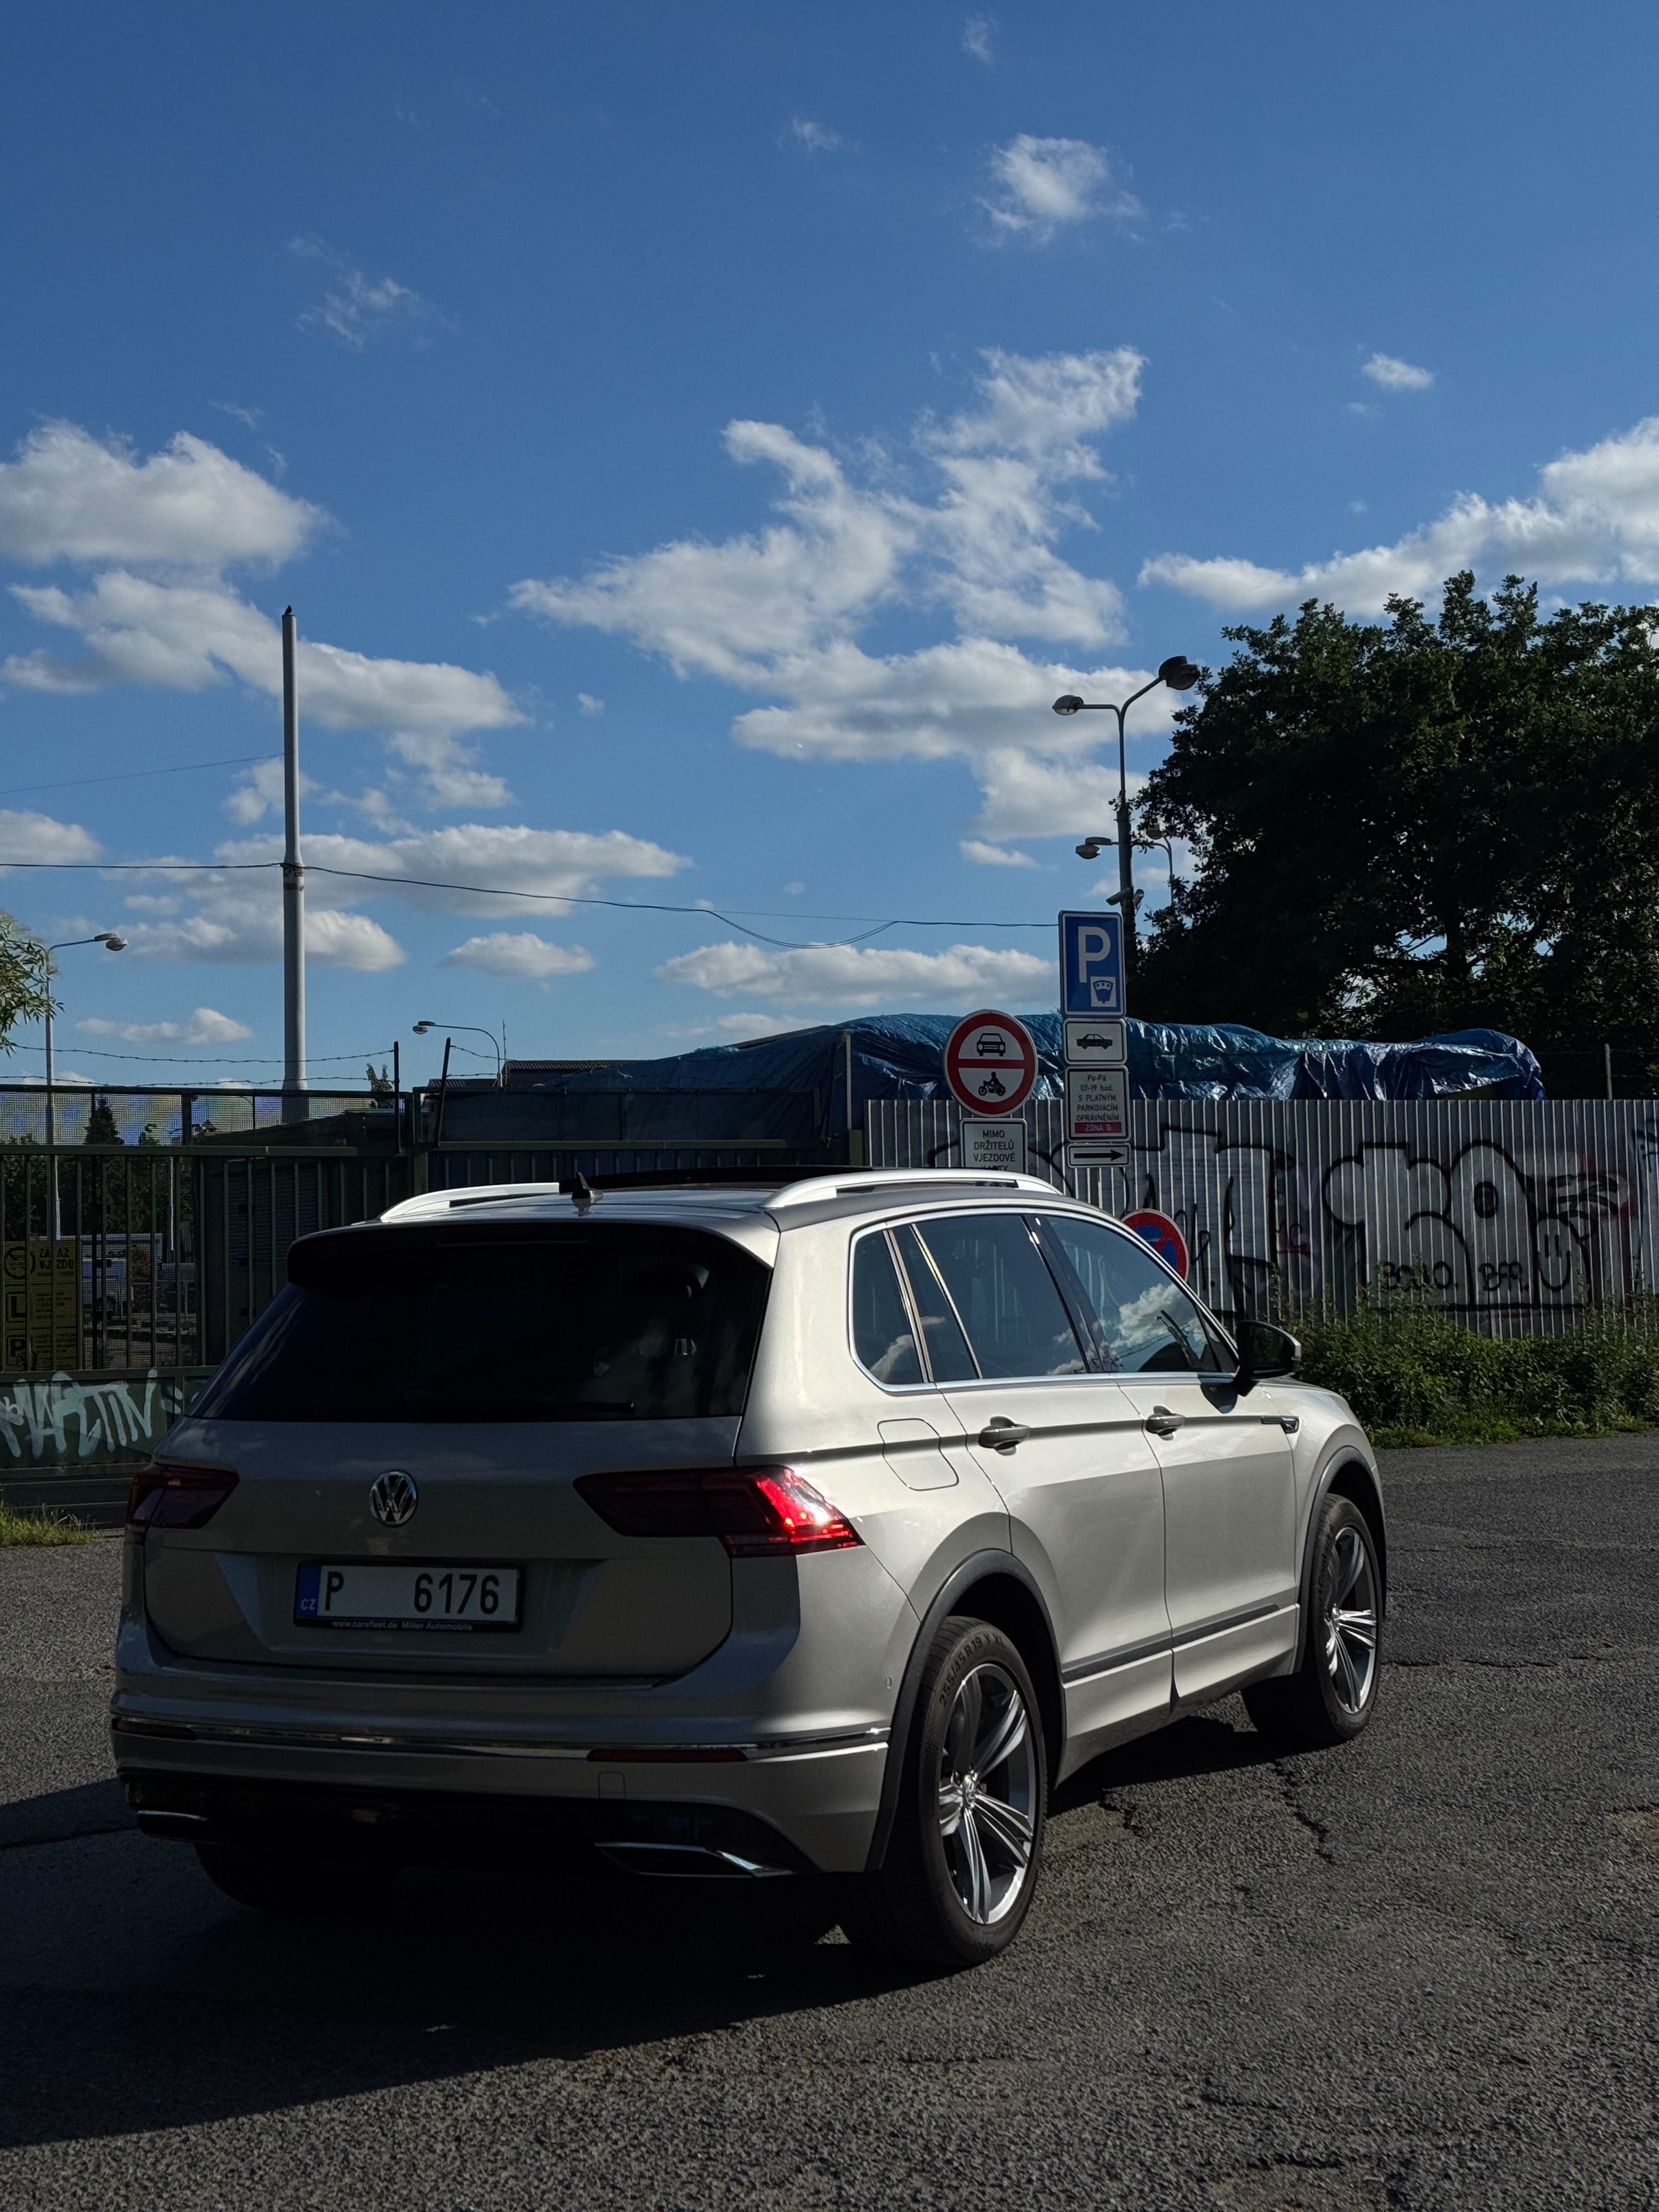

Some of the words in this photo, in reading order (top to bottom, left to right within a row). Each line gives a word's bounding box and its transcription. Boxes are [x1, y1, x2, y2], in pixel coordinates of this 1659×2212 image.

[1078, 926, 1110, 983] P
[1086, 1093, 1116, 1101] PLATNÝM
[1076, 1103, 1118, 1111] PARKOVACÍM
[1076, 1113, 1119, 1121] OPRÁVNĚNÍM
[1086, 1123, 1103, 1131] ZÓNA
[983, 1130, 1005, 1138] MIMO
[974, 1139, 1014, 1150] DRŽITELŮ
[973, 1152, 1015, 1162] VJEZDOVÉ
[40, 1259, 74, 1269] VJZDU
[301, 1598, 317, 1611] CZ
[325, 1572, 343, 1610] P
[414, 1573, 499, 1614] 6176
